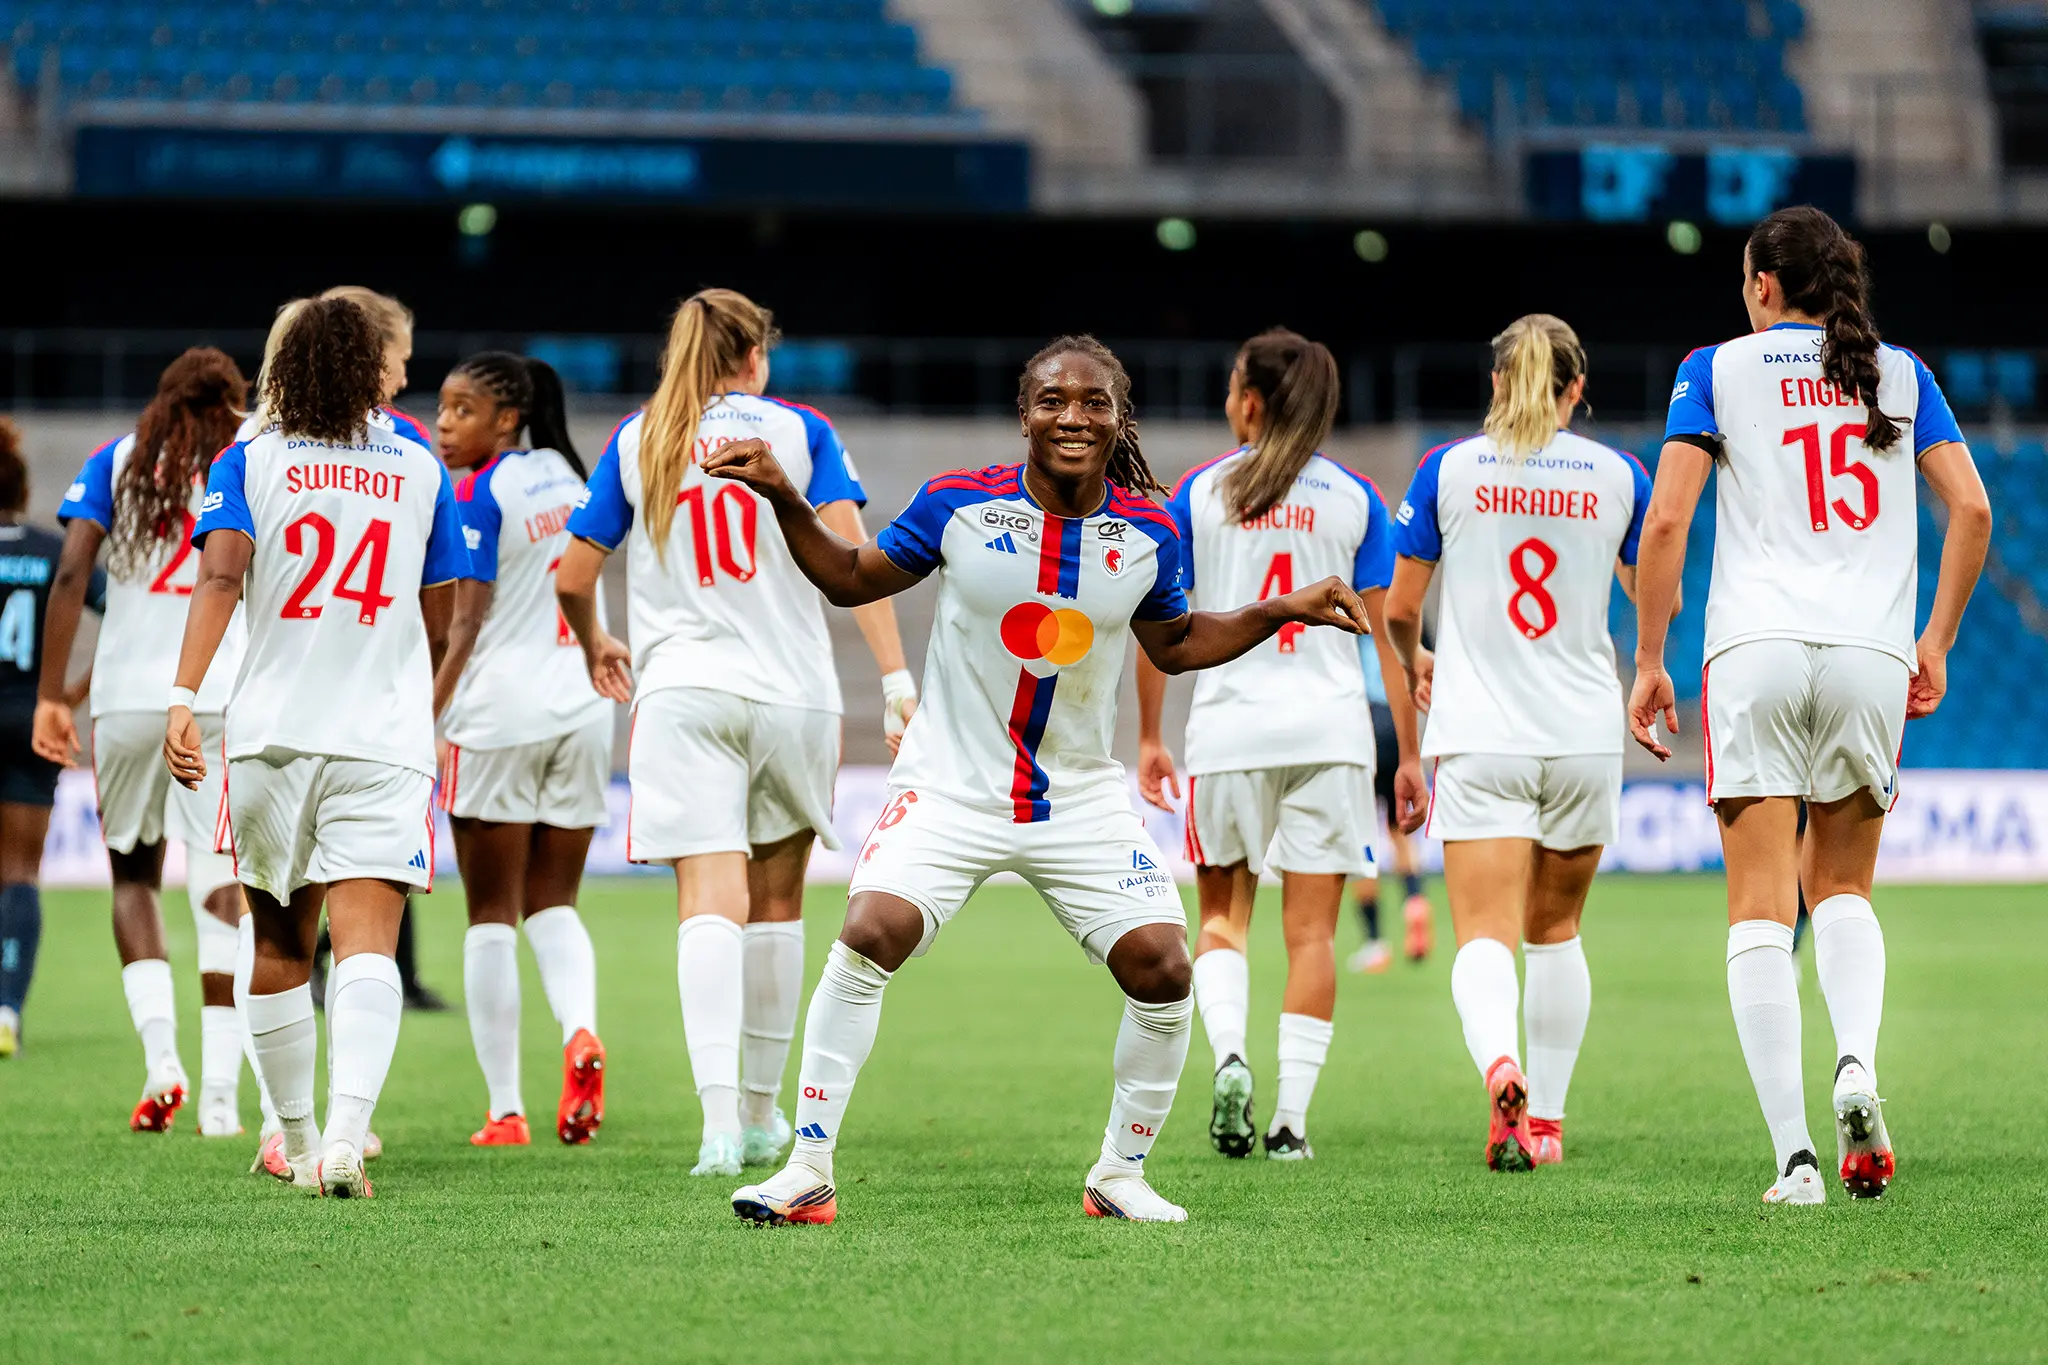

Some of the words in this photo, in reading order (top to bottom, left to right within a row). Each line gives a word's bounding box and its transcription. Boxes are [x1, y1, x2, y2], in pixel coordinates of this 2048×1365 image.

[1780, 376, 1860, 407] ENGE
[286, 463, 406, 503] SWIEROT
[1780, 421, 1880, 532] 15
[984, 510, 1031, 532] ÖKO
[1475, 484, 1599, 520] SHRADER
[675, 483, 757, 588] 10
[280, 511, 396, 627] 24
[1508, 536, 1559, 640] 8
[1257, 552, 1306, 654] 4
[804, 1086, 828, 1101] OL
[1131, 1123, 1154, 1137] OL
